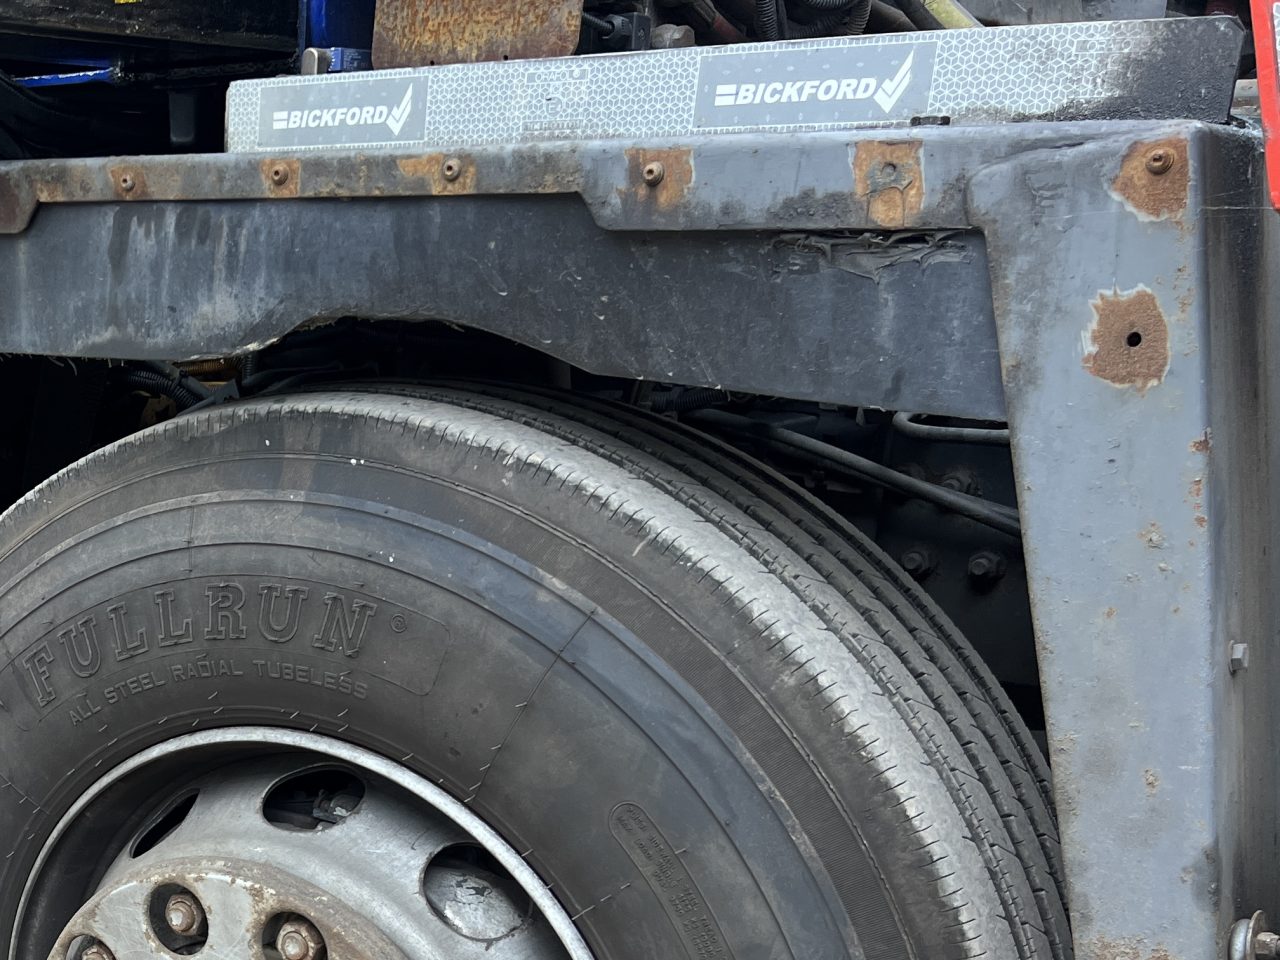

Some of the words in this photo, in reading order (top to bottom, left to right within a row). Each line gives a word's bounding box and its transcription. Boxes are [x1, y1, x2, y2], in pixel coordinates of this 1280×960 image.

[735, 77, 877, 106] BICKFORD
[287, 104, 388, 129] BICKFORD
[23, 581, 379, 708] FULLRUN
[69, 694, 103, 726] ALL
[104, 672, 167, 704] STEEL
[172, 657, 245, 682] RADIAL
[253, 659, 369, 700] TUBELESS
